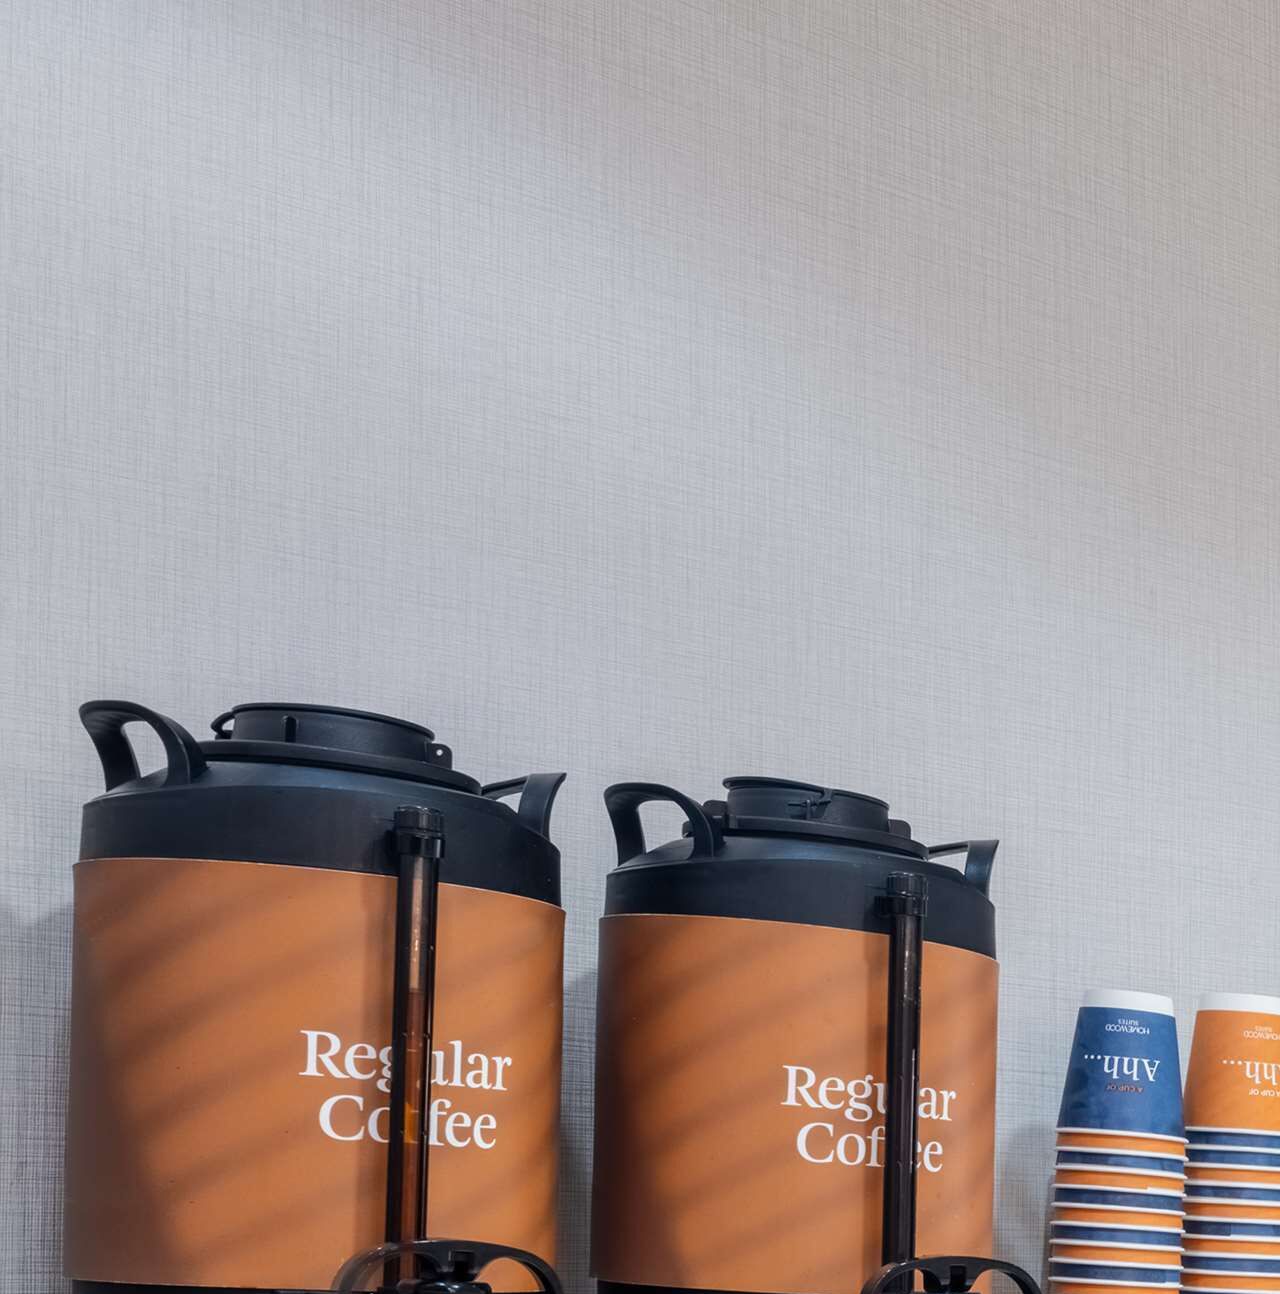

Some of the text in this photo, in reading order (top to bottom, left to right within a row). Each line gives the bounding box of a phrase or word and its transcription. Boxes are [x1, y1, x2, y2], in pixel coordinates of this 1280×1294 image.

[1105, 1023, 1150, 1035] HOMEWOOD
[780, 1064, 957, 1123] Regar
[1084, 1053, 1161, 1082] Ahh...
[318, 1094, 497, 1150] Cofee
[796, 1121, 944, 1173] Cofe
